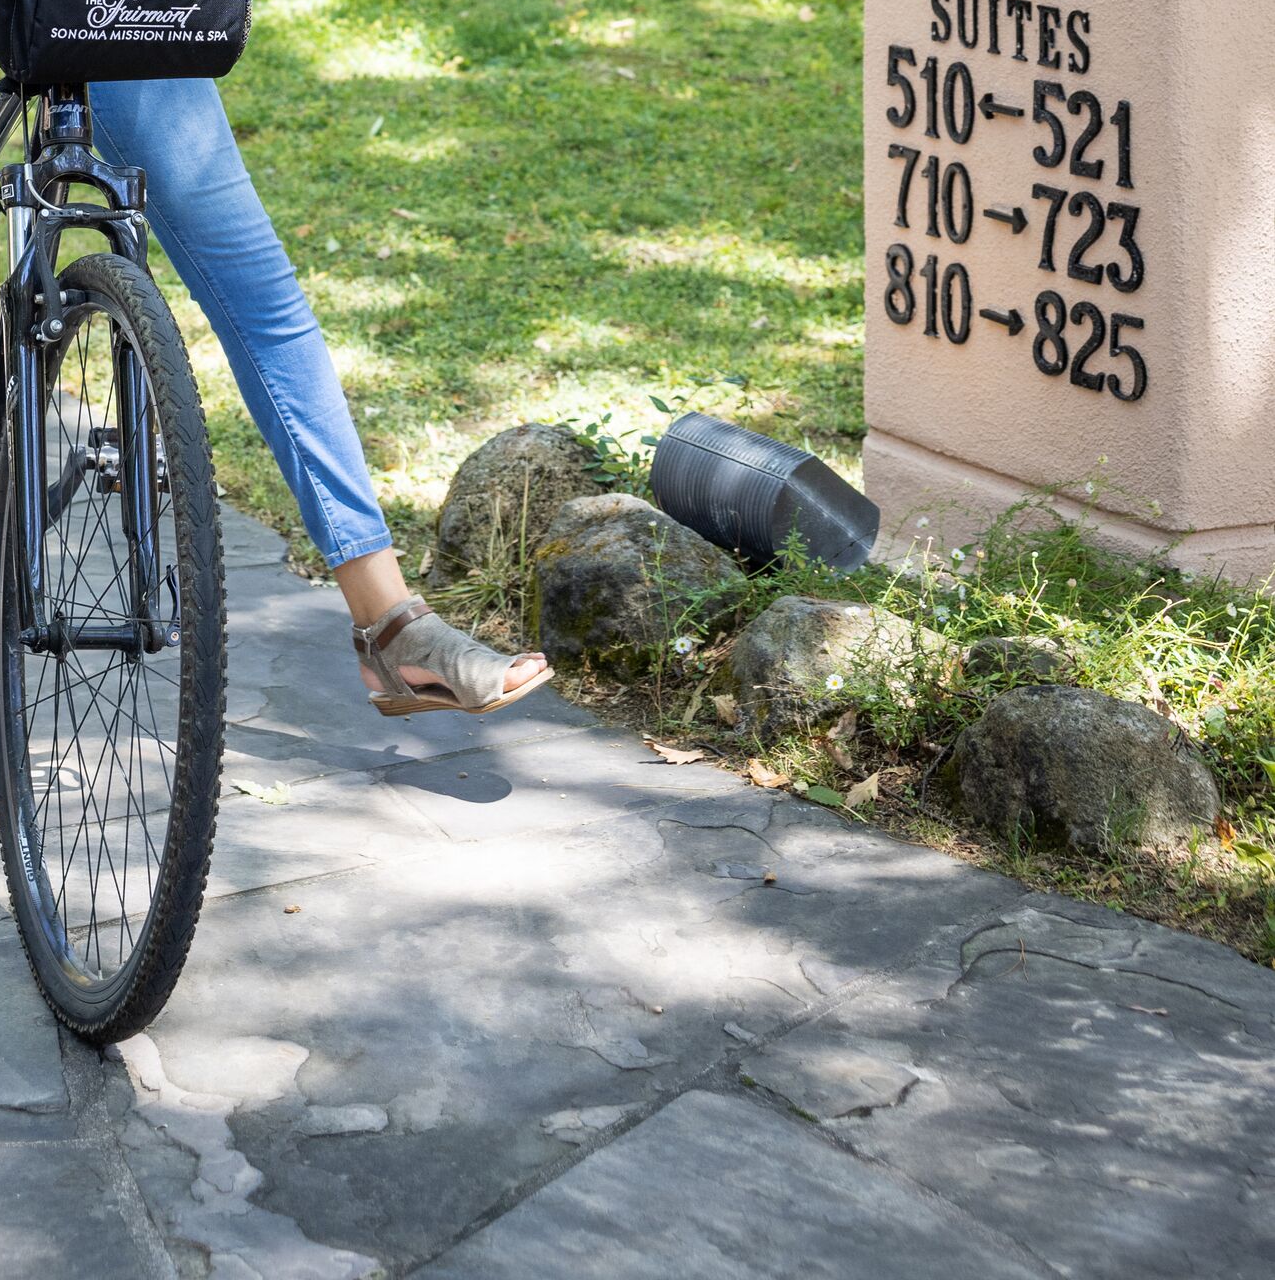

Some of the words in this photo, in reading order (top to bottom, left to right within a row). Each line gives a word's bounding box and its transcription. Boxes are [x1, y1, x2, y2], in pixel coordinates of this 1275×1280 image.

[50, 27, 107, 41] SONOMA
[109, 29, 164, 42] MISSION
[167, 30, 193, 42] INN
[194, 30, 205, 42] &
[206, 30, 229, 42] SPA
[48, 104, 89, 115] GIANT
[886, 44, 975, 145] 510
[1032, 79, 1135, 190] 521
[887, 143, 974, 245] 710
[1031, 182, 1145, 294] 723
[884, 242, 973, 345] 810
[1032, 289, 1148, 402] 825
[21, 842, 35, 882] GIANT
